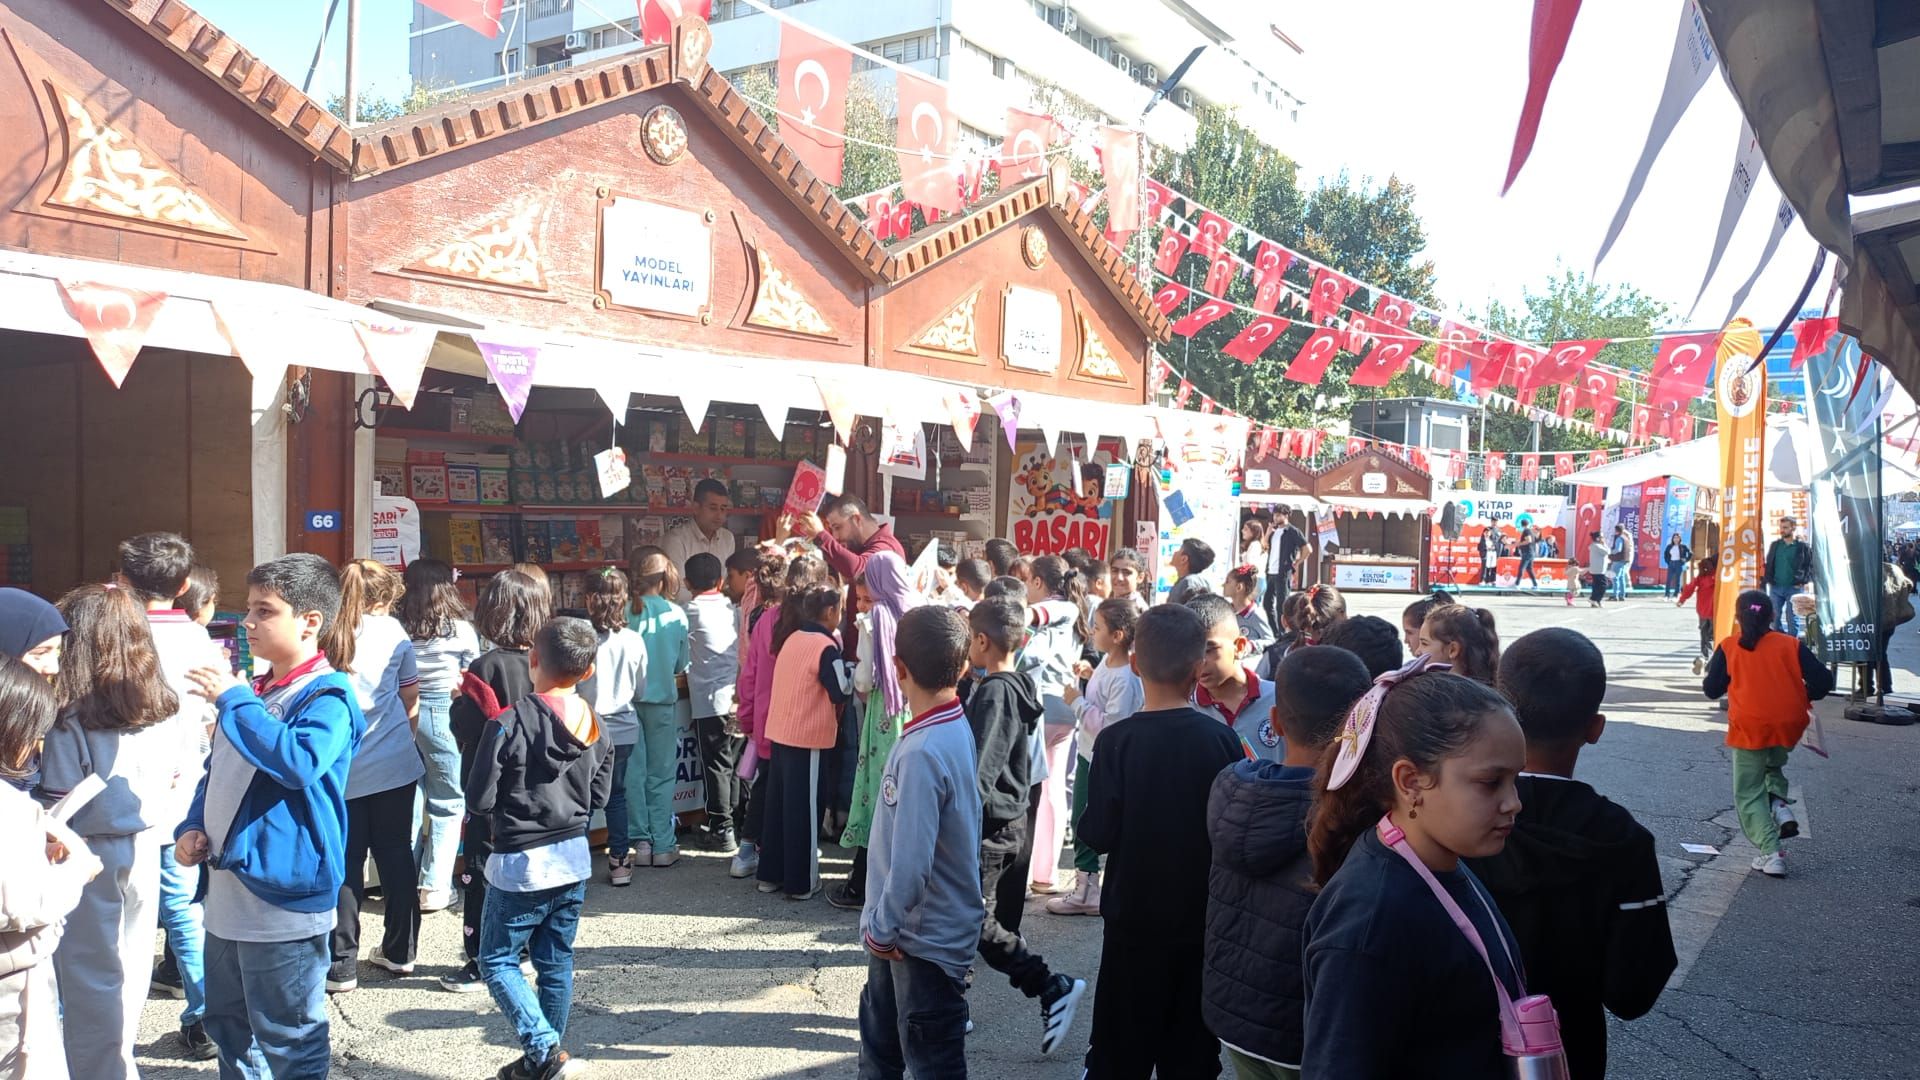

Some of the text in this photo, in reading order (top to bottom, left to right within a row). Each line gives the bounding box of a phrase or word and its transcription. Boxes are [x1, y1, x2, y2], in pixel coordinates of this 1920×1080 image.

[635, 255, 683, 274] MODEL
[622, 268, 694, 292] YAYINLARI
[1478, 500, 1513, 510] KİTAP
[311, 514, 334, 529] 66
[1478, 510, 1513, 520] FUARI
